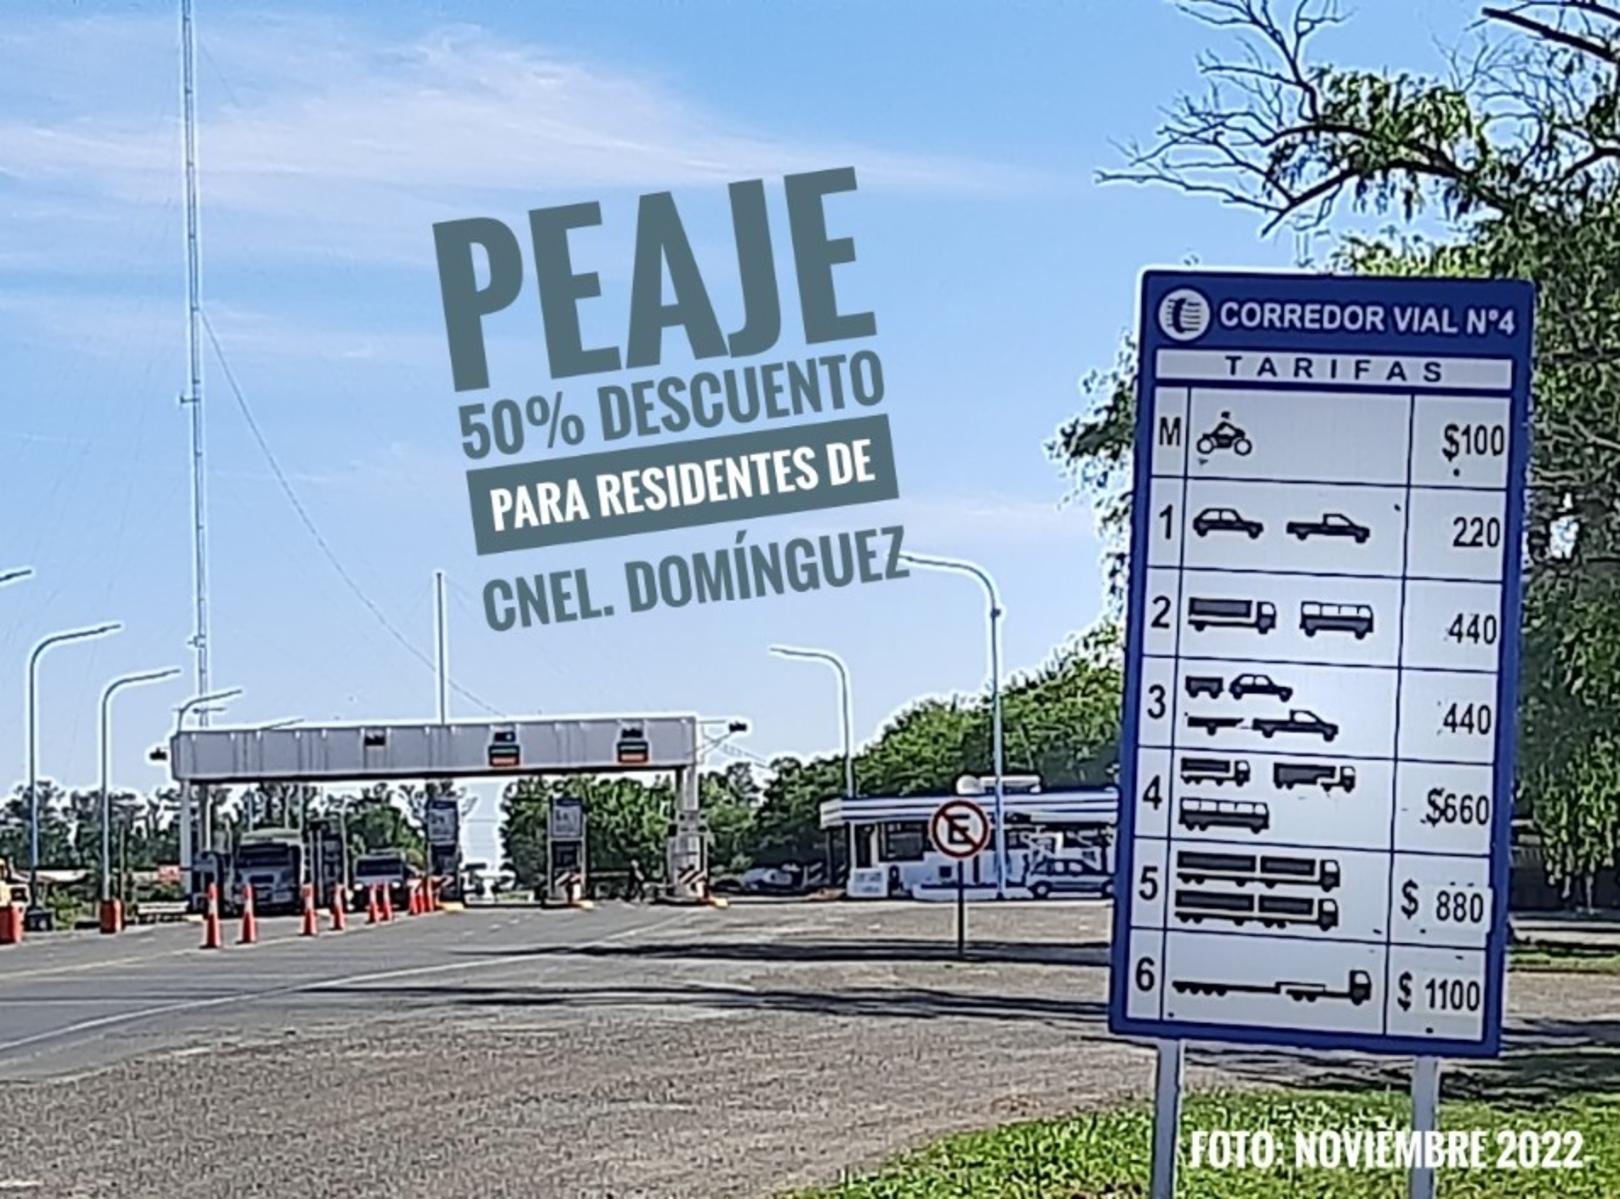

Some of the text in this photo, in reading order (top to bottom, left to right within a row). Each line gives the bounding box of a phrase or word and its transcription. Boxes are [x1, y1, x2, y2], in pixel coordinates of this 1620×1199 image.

[1220, 301, 1385, 332] CORREDOR
[1392, 307, 1458, 334] VIAL
[1225, 355, 1443, 382] TARIFAS
[1158, 417, 1181, 446] M
[1442, 423, 1504, 462] $100
[1159, 505, 1173, 540] 1
[1452, 517, 1501, 547] 220
[1151, 595, 1171, 629] 2
[1449, 613, 1497, 644] 440
[1147, 684, 1166, 719] 3
[1443, 703, 1491, 735] 440
[1142, 775, 1162, 811] 4
[1426, 788, 1489, 827] $660
[1139, 866, 1158, 901] 5
[1401, 879, 1484, 923] $ 880
[1135, 957, 1155, 992] 6
[1397, 971, 1480, 1012] $ 1100
